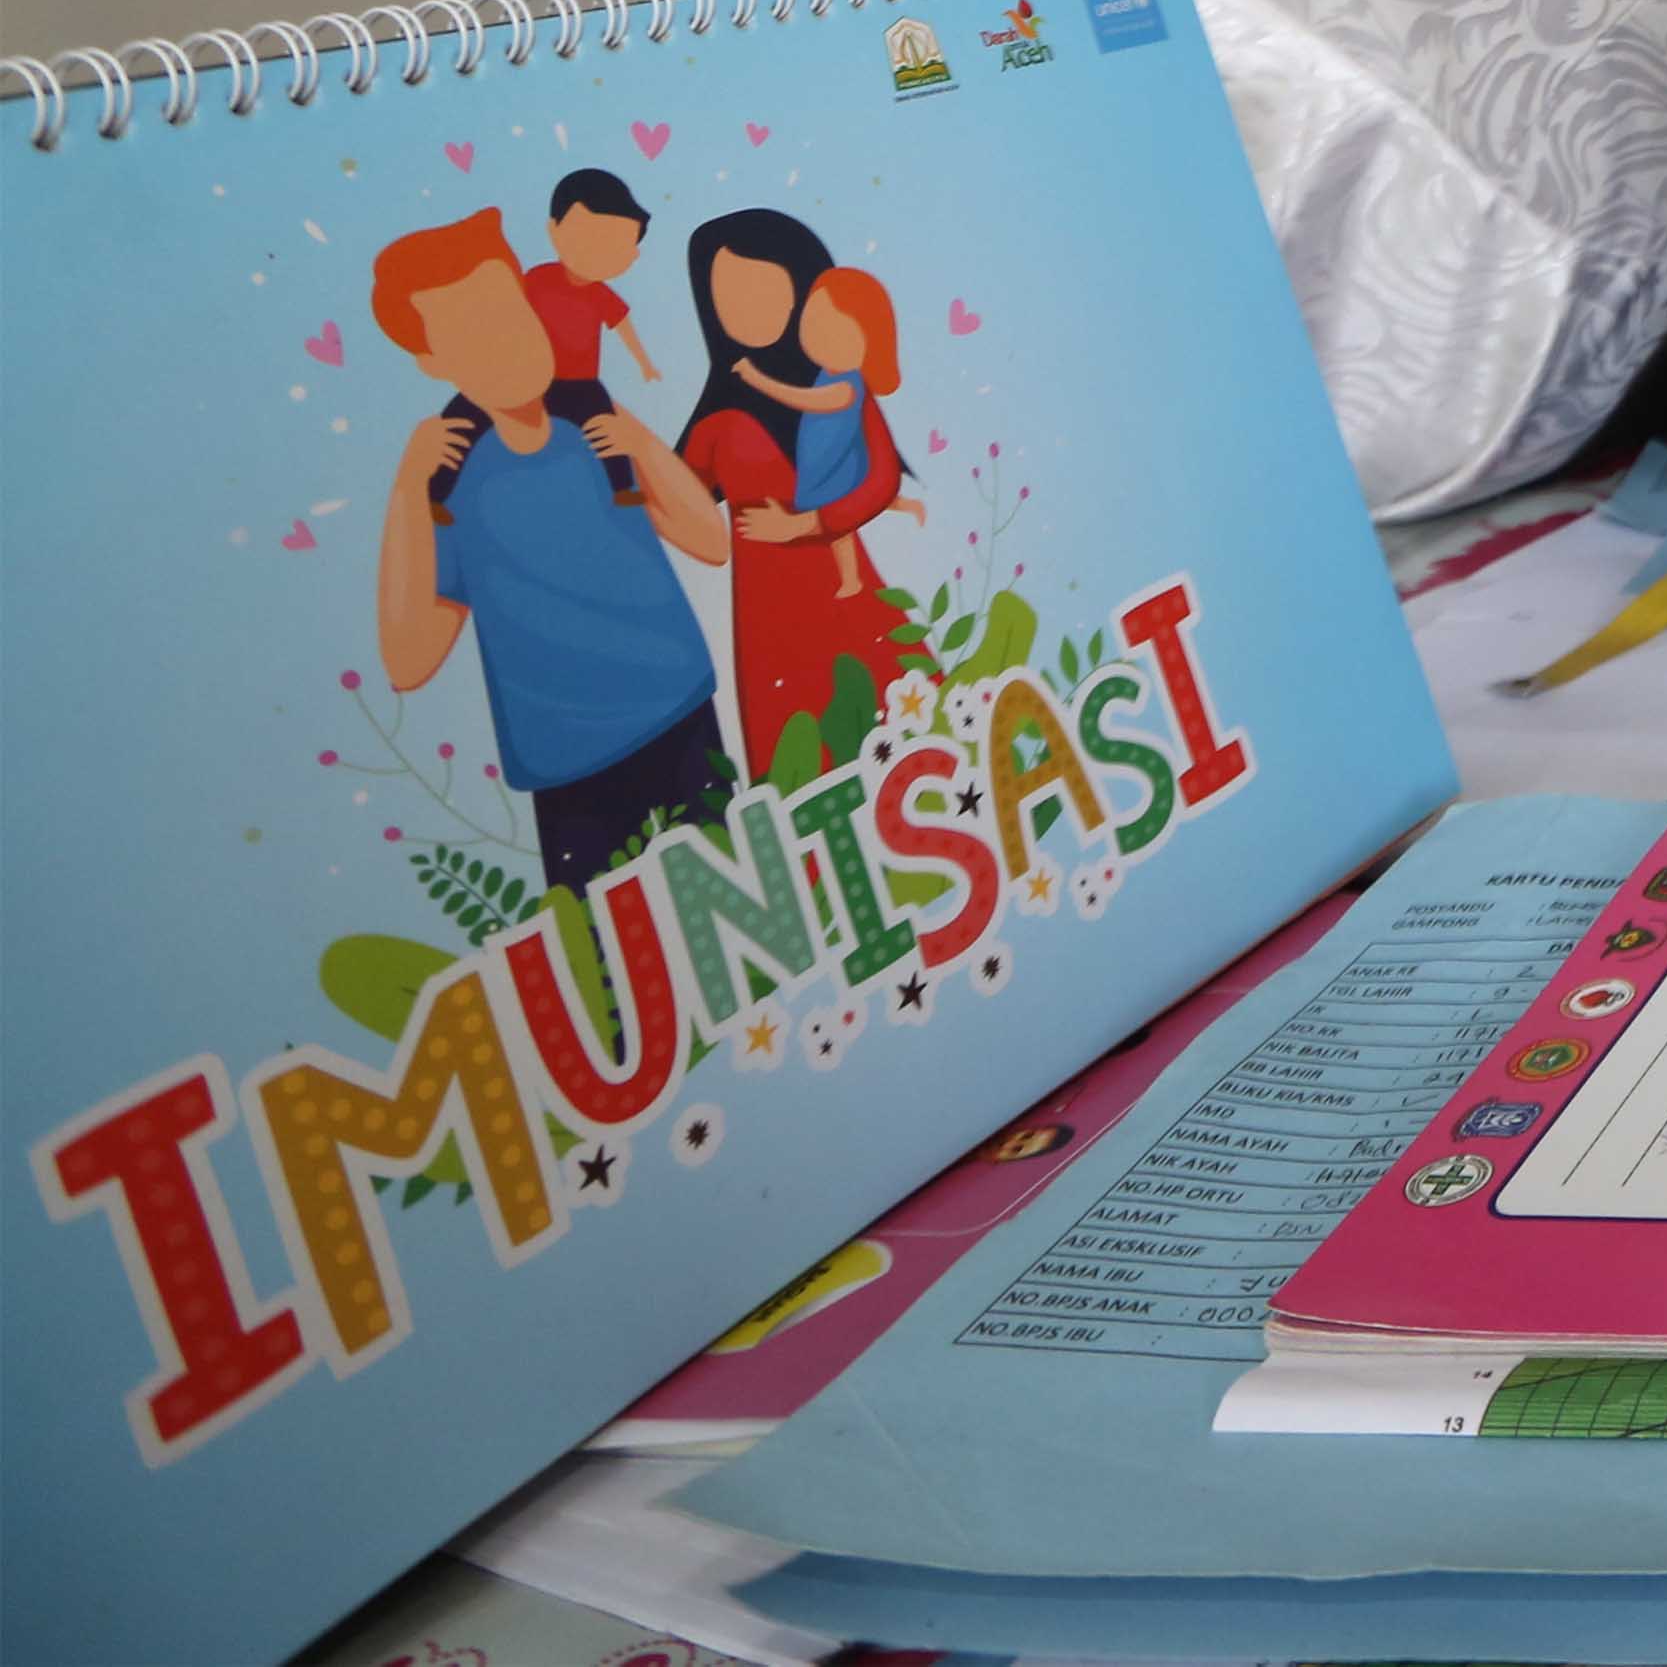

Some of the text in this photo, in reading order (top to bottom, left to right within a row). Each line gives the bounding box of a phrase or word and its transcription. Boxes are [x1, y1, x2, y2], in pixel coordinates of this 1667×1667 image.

[48, 582, 1250, 1447] IMUNISASI
[1264, 1041, 1361, 1062] NIK BALITA
[1217, 1080, 1272, 1099] BUKU
[1193, 1103, 1236, 1120] IMD
[1168, 1125, 1290, 1153] NAMA AYAH
[1142, 1152, 1239, 1176] NIK AYAH
[1184, 1184, 1245, 1206] ORTU
[1087, 1208, 1181, 1227] ALAMAT
[1060, 1233, 1206, 1258] ASI EKSKLUSIF
[1033, 1261, 1145, 1283] NAMA IBU
[1093, 1298, 1156, 1316] ANAK
[1062, 1327, 1105, 1343] IBU
[1443, 1416, 1465, 1433] 13
